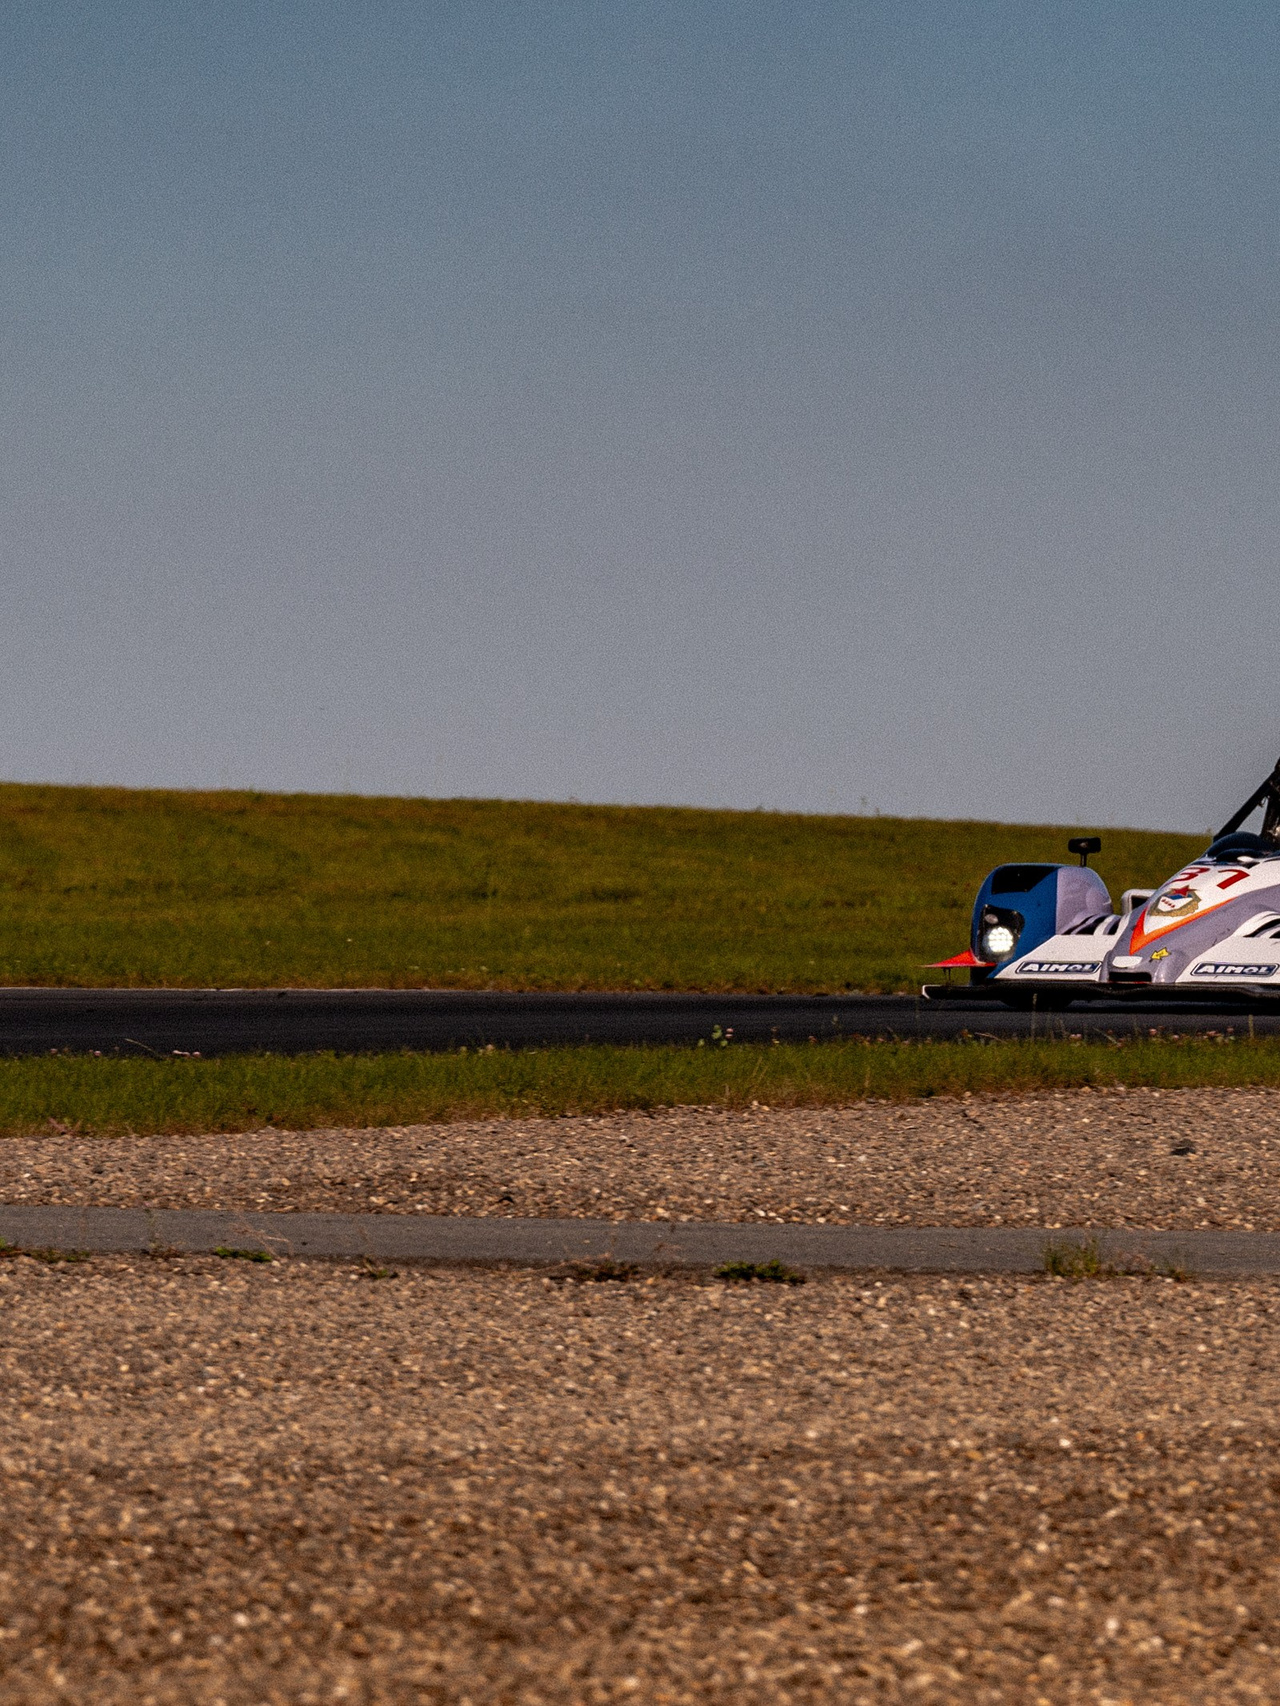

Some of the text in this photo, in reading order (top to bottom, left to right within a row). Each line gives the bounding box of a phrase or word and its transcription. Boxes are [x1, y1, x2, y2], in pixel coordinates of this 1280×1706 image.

[1162, 866, 1250, 890] 31
[1021, 963, 1094, 973] AIMOL
[1196, 964, 1271, 974] AIMOL
